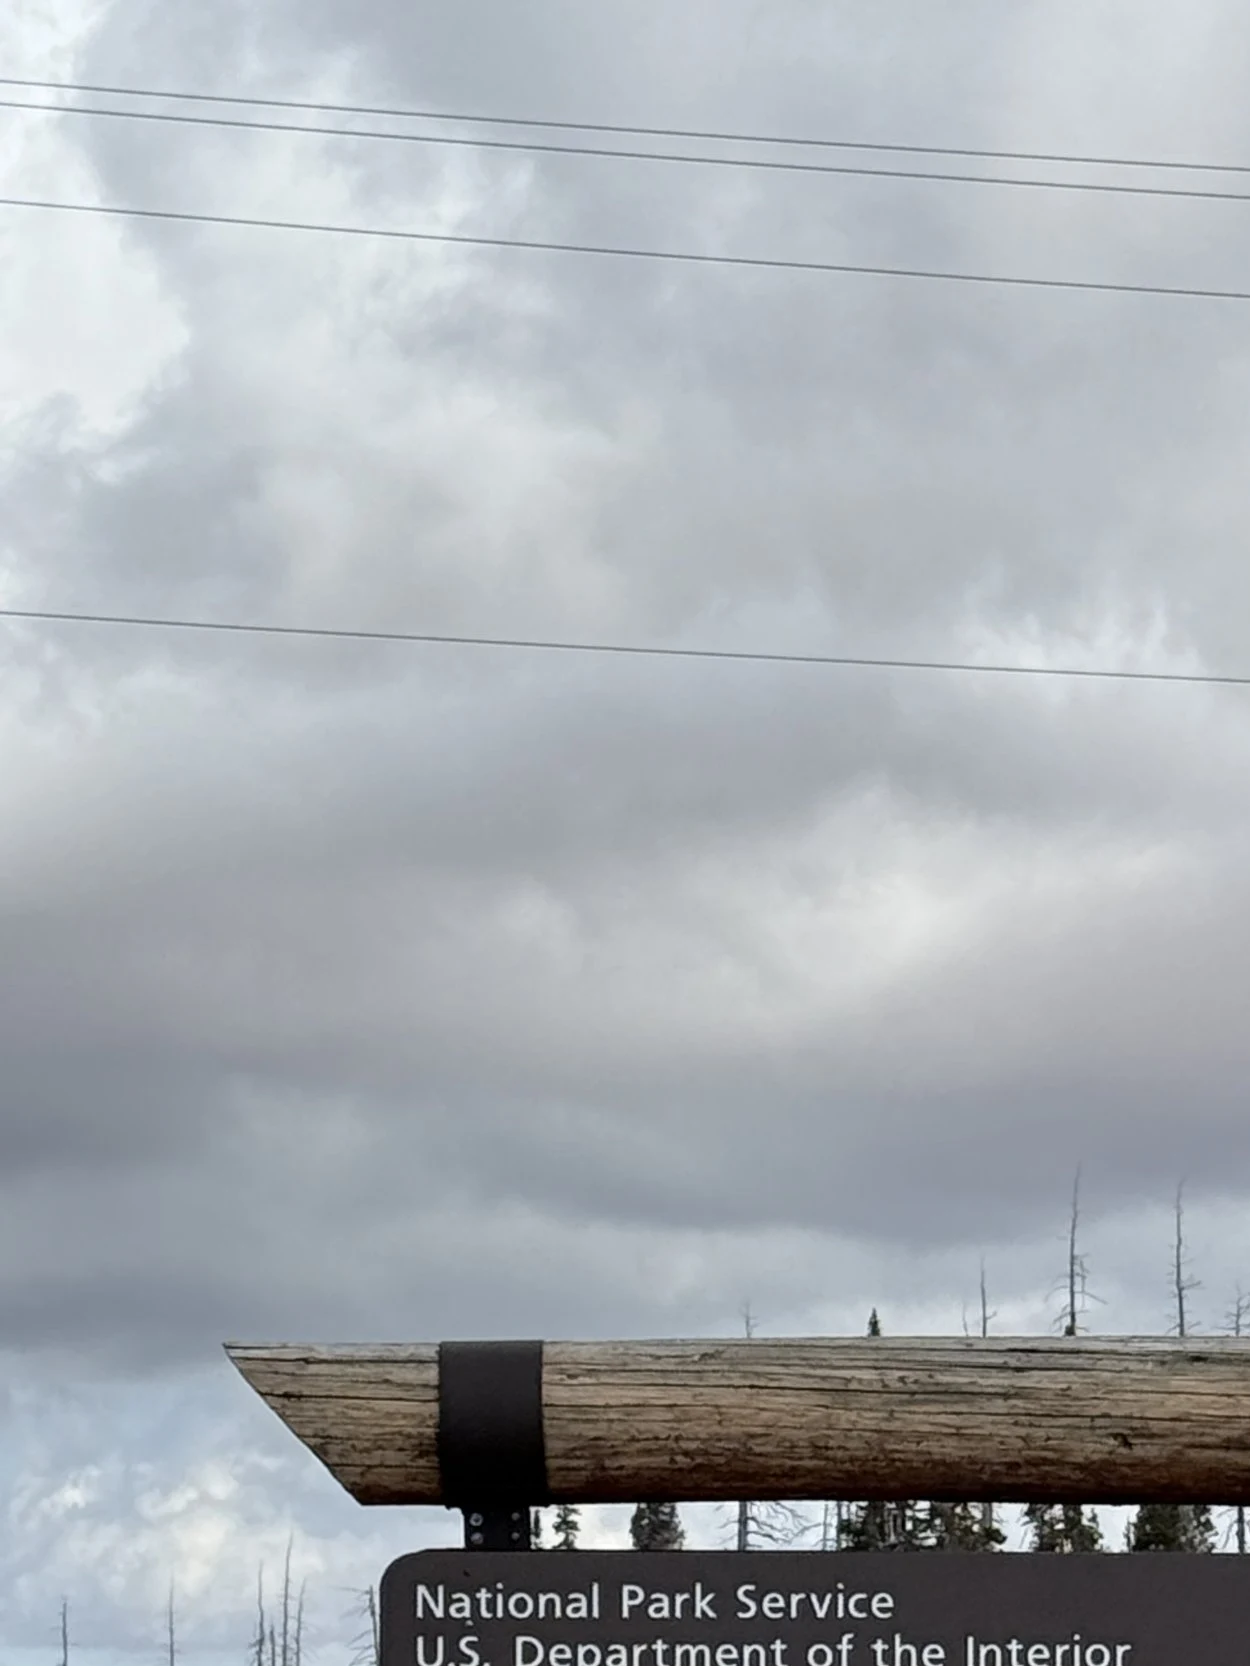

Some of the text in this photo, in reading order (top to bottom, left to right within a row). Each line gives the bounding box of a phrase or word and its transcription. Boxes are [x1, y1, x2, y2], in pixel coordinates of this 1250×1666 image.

[416, 1582, 894, 1619] National Park Service
